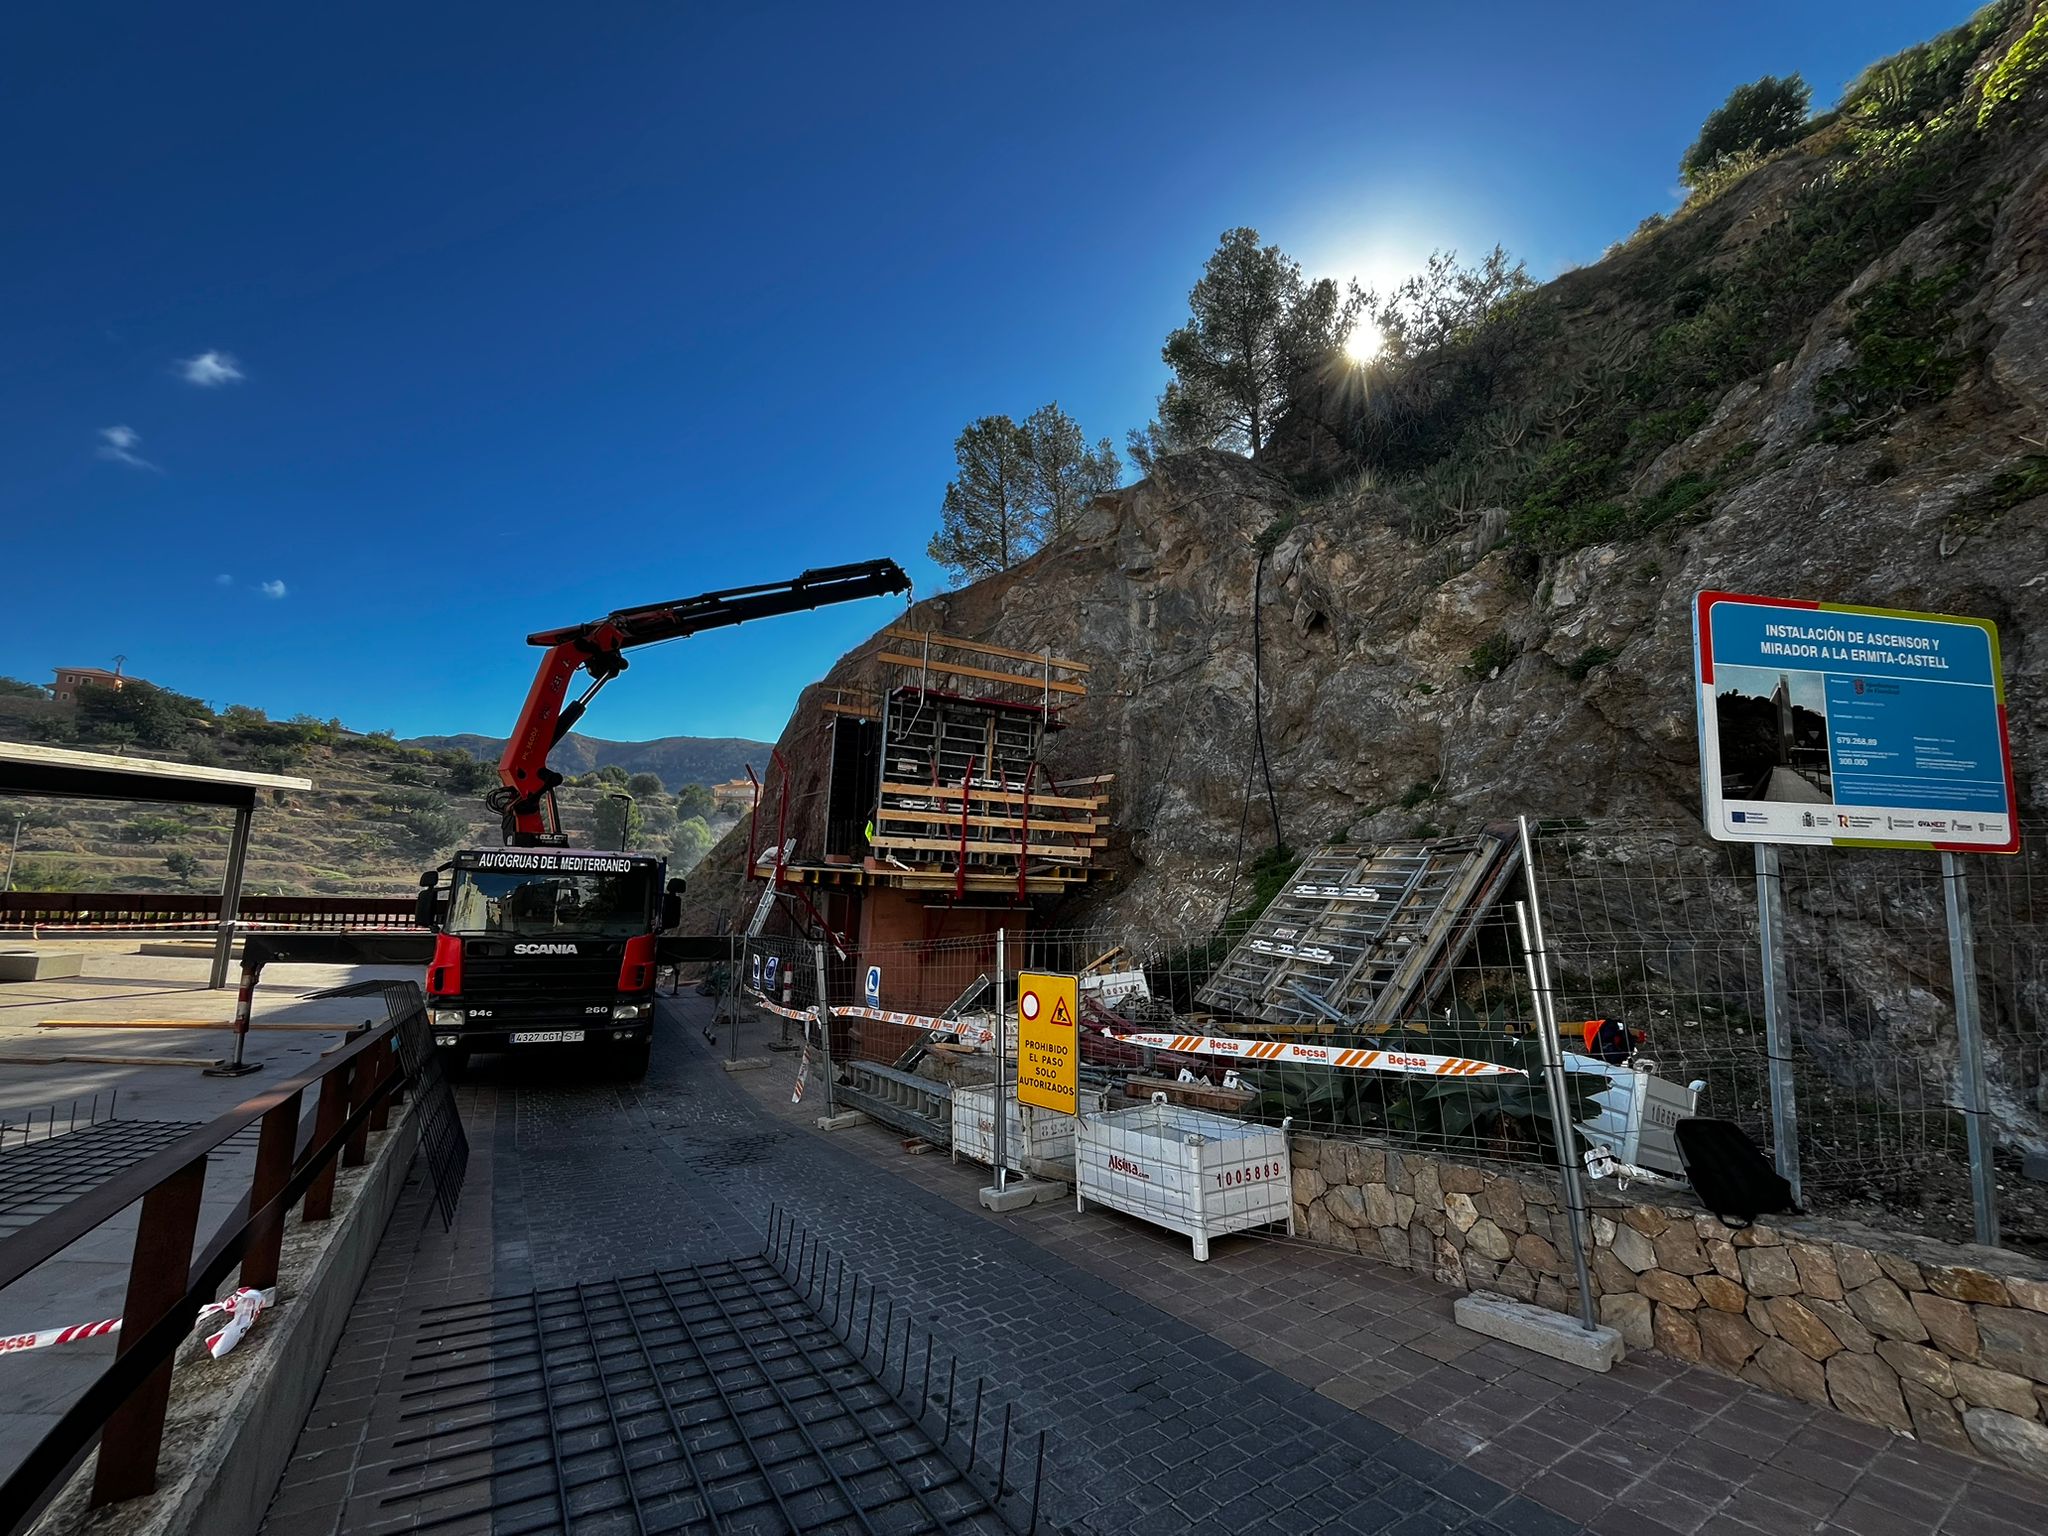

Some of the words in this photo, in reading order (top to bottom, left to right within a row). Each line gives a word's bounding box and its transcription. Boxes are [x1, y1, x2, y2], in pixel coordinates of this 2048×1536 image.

[1765, 624, 1845, 643] INSTALACIÓN
[1848, 631, 1864, 644] DE
[1867, 633, 1930, 650] ASCENSOR
[1932, 639, 1940, 651] Y
[1760, 642, 1818, 658] MIRADOR
[1821, 647, 1830, 659] A
[1833, 648, 1848, 661] LA
[1851, 649, 1949, 669] ERMITA-CASTELL
[478, 853, 539, 869] AUTOGRUAS
[540, 855, 558, 870] DEL
[560, 856, 631, 873] MEDITERRANEO
[514, 943, 578, 955] SCANIA
[584, 1006, 609, 1014] 260
[516, 1033, 540, 1042] 4327
[542, 1032, 561, 1041] CGT
[1025, 1039, 1068, 1055] PROHIBIDO
[1209, 1039, 1239, 1051] Becsa
[1292, 1046, 1327, 1058] Becsa
[1029, 1053, 1038, 1063] EL
[1041, 1055, 1063, 1067] PASO
[1387, 1054, 1427, 1067] Becsa
[1035, 1066, 1057, 1079] SOLO
[1019, 1076, 1074, 1096] AUTORIZADOS
[1216, 1162, 1279, 1188] 1005889
